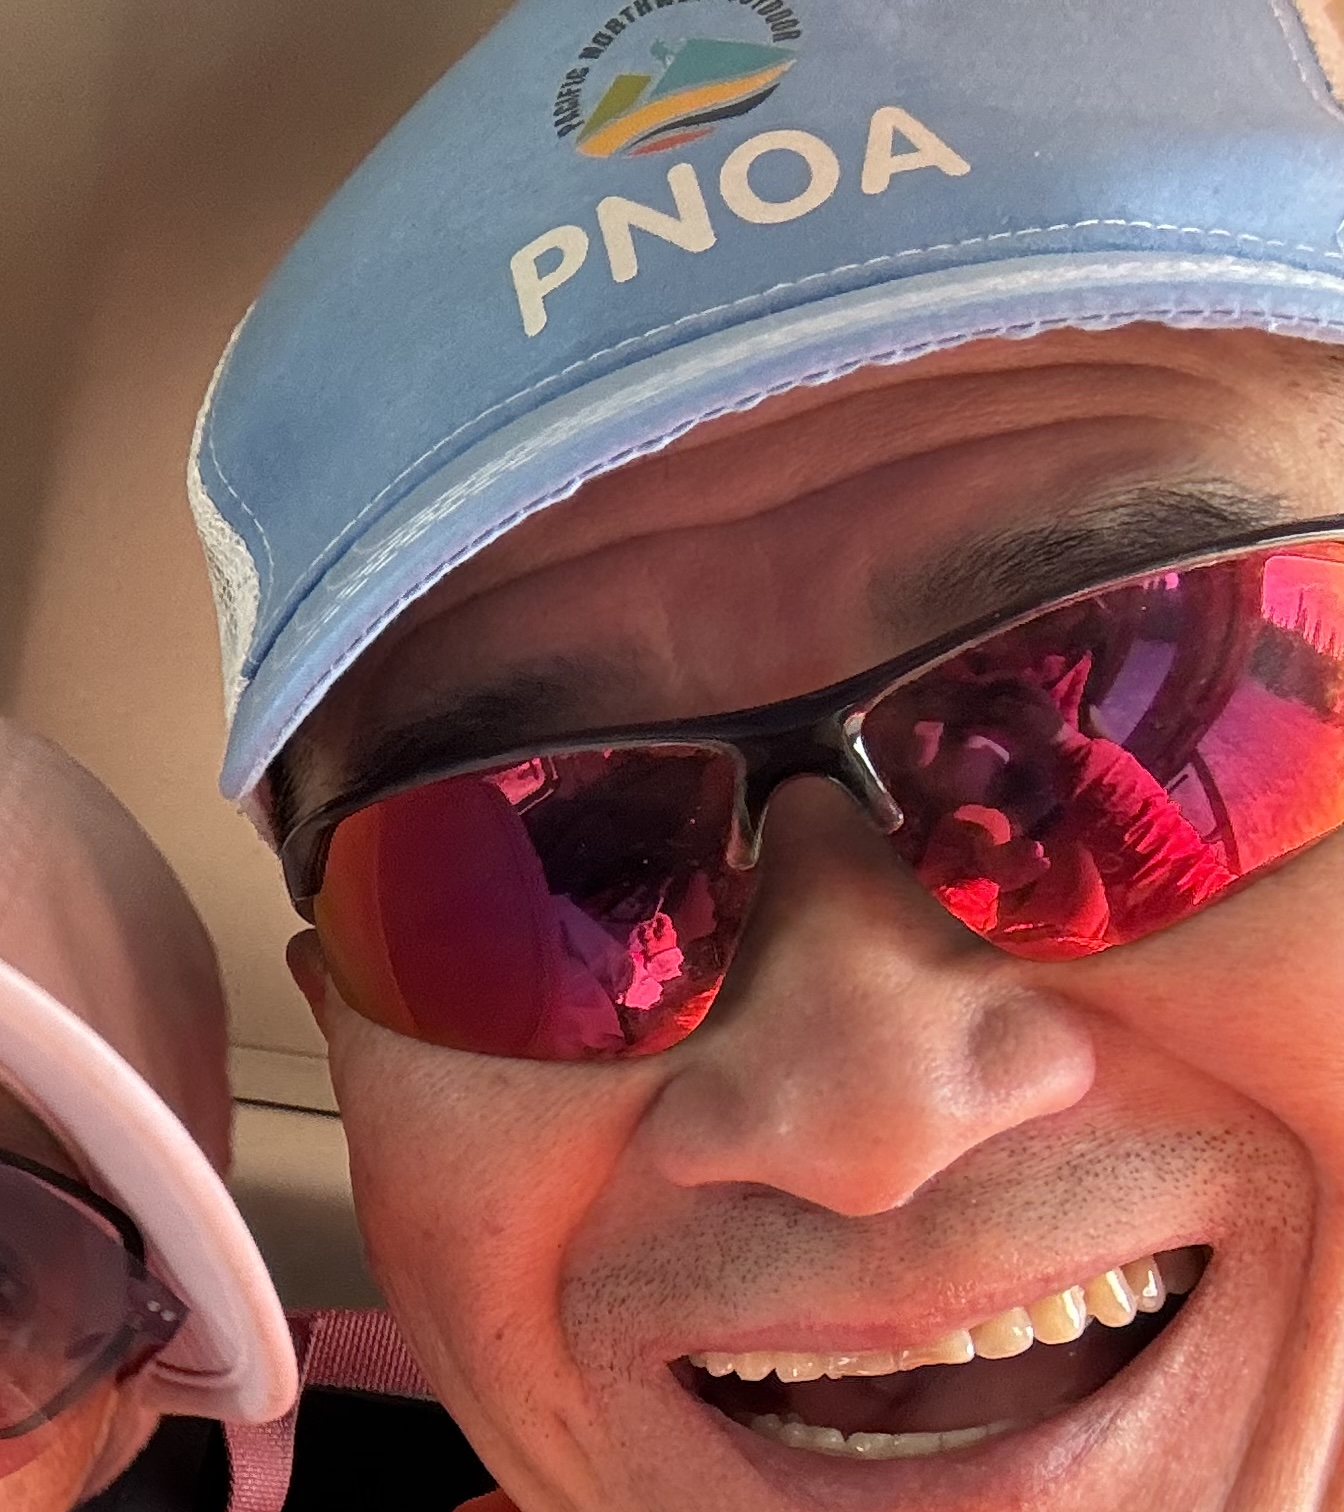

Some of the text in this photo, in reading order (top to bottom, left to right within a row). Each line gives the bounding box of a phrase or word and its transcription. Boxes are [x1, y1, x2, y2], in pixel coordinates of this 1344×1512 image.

[578, 0, 701, 59] NORTH
[727, 0, 801, 42] DOOR
[511, 106, 971, 337] PNOA
